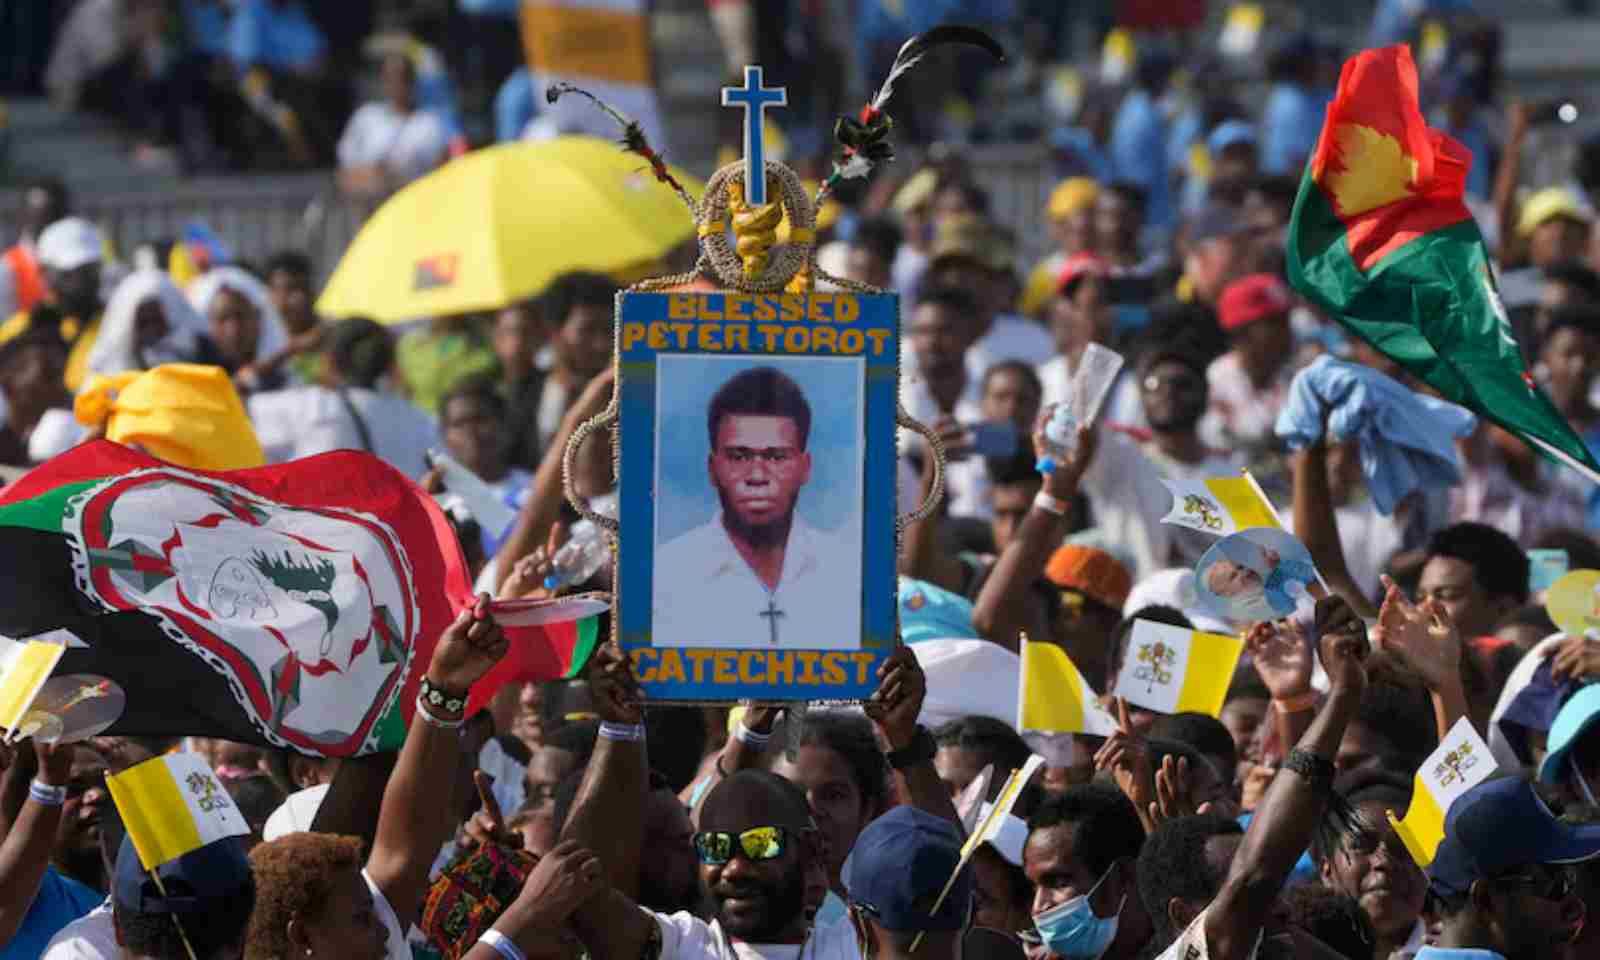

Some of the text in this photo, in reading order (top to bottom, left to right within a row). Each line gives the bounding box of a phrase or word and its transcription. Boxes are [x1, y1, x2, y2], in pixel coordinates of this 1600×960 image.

[668, 295, 860, 322] BLESSED
[622, 320, 892, 356] PETER TOROT
[630, 647, 876, 684] CATECHIST
